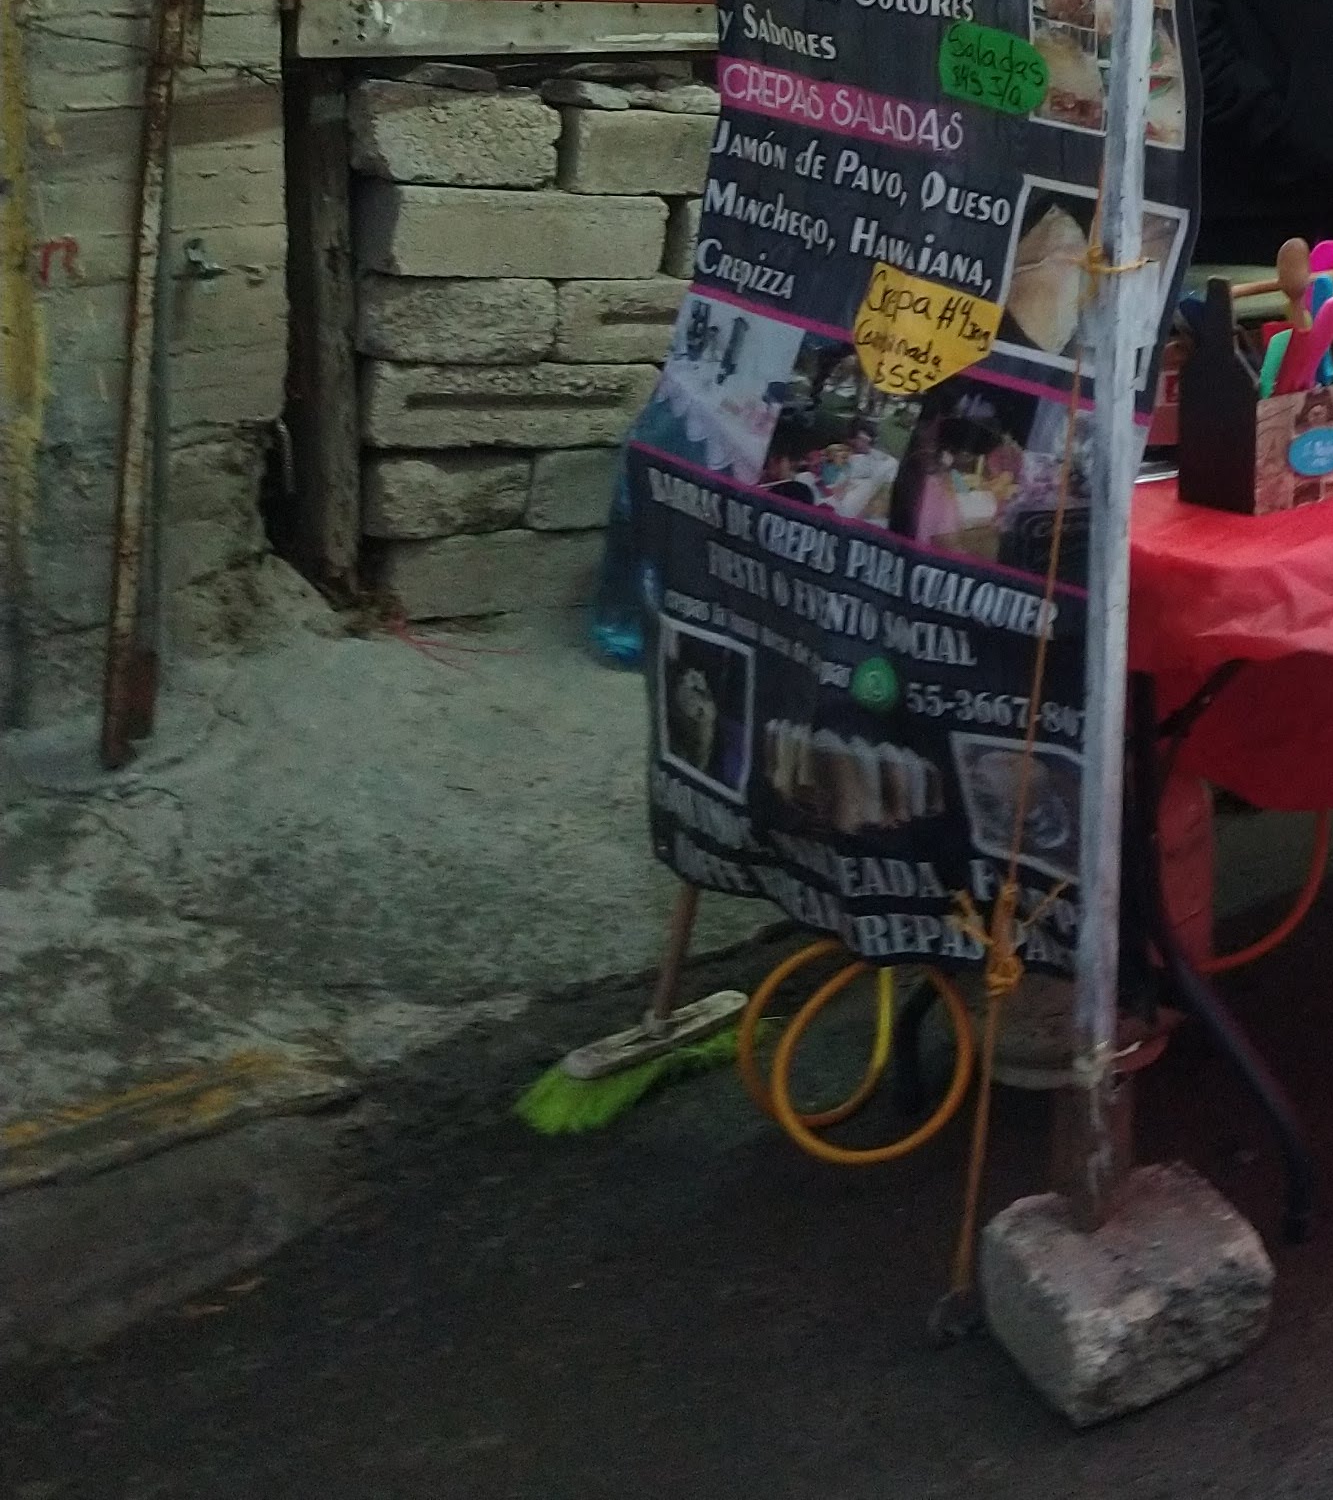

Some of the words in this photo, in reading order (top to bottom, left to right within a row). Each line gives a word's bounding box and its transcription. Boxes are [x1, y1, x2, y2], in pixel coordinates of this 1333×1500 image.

[723, 62, 824, 121] CREPAS
[830, 81, 965, 153] SALADAS
[757, 510, 840, 575] CREPAS
[844, 539, 905, 598] PARA
[910, 564, 1060, 641] CUALQUIER
